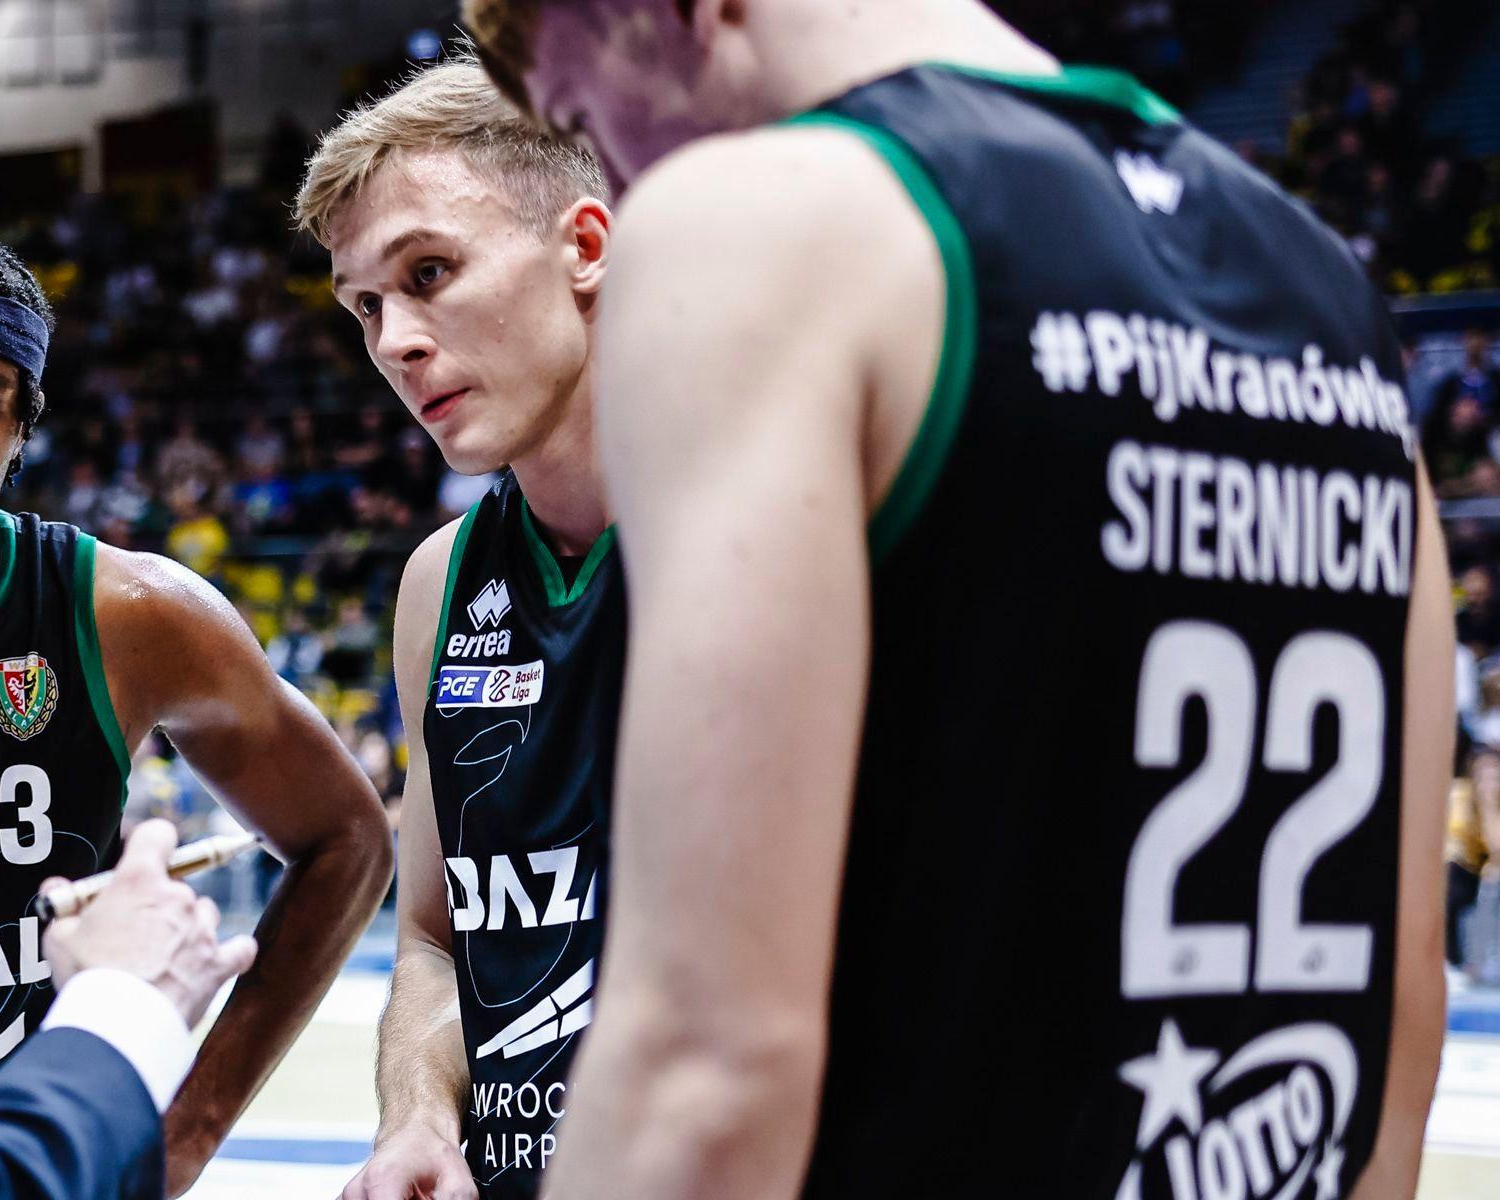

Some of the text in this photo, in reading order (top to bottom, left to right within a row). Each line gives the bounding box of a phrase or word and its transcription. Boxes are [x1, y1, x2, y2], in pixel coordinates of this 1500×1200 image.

[1101, 438, 1412, 597] STERNICKI
[439, 676, 480, 697] PGE
[512, 686, 530, 702] Liga
[515, 668, 541, 684] Basket
[0, 764, 53, 865] 3
[1120, 618, 1387, 999] 22
